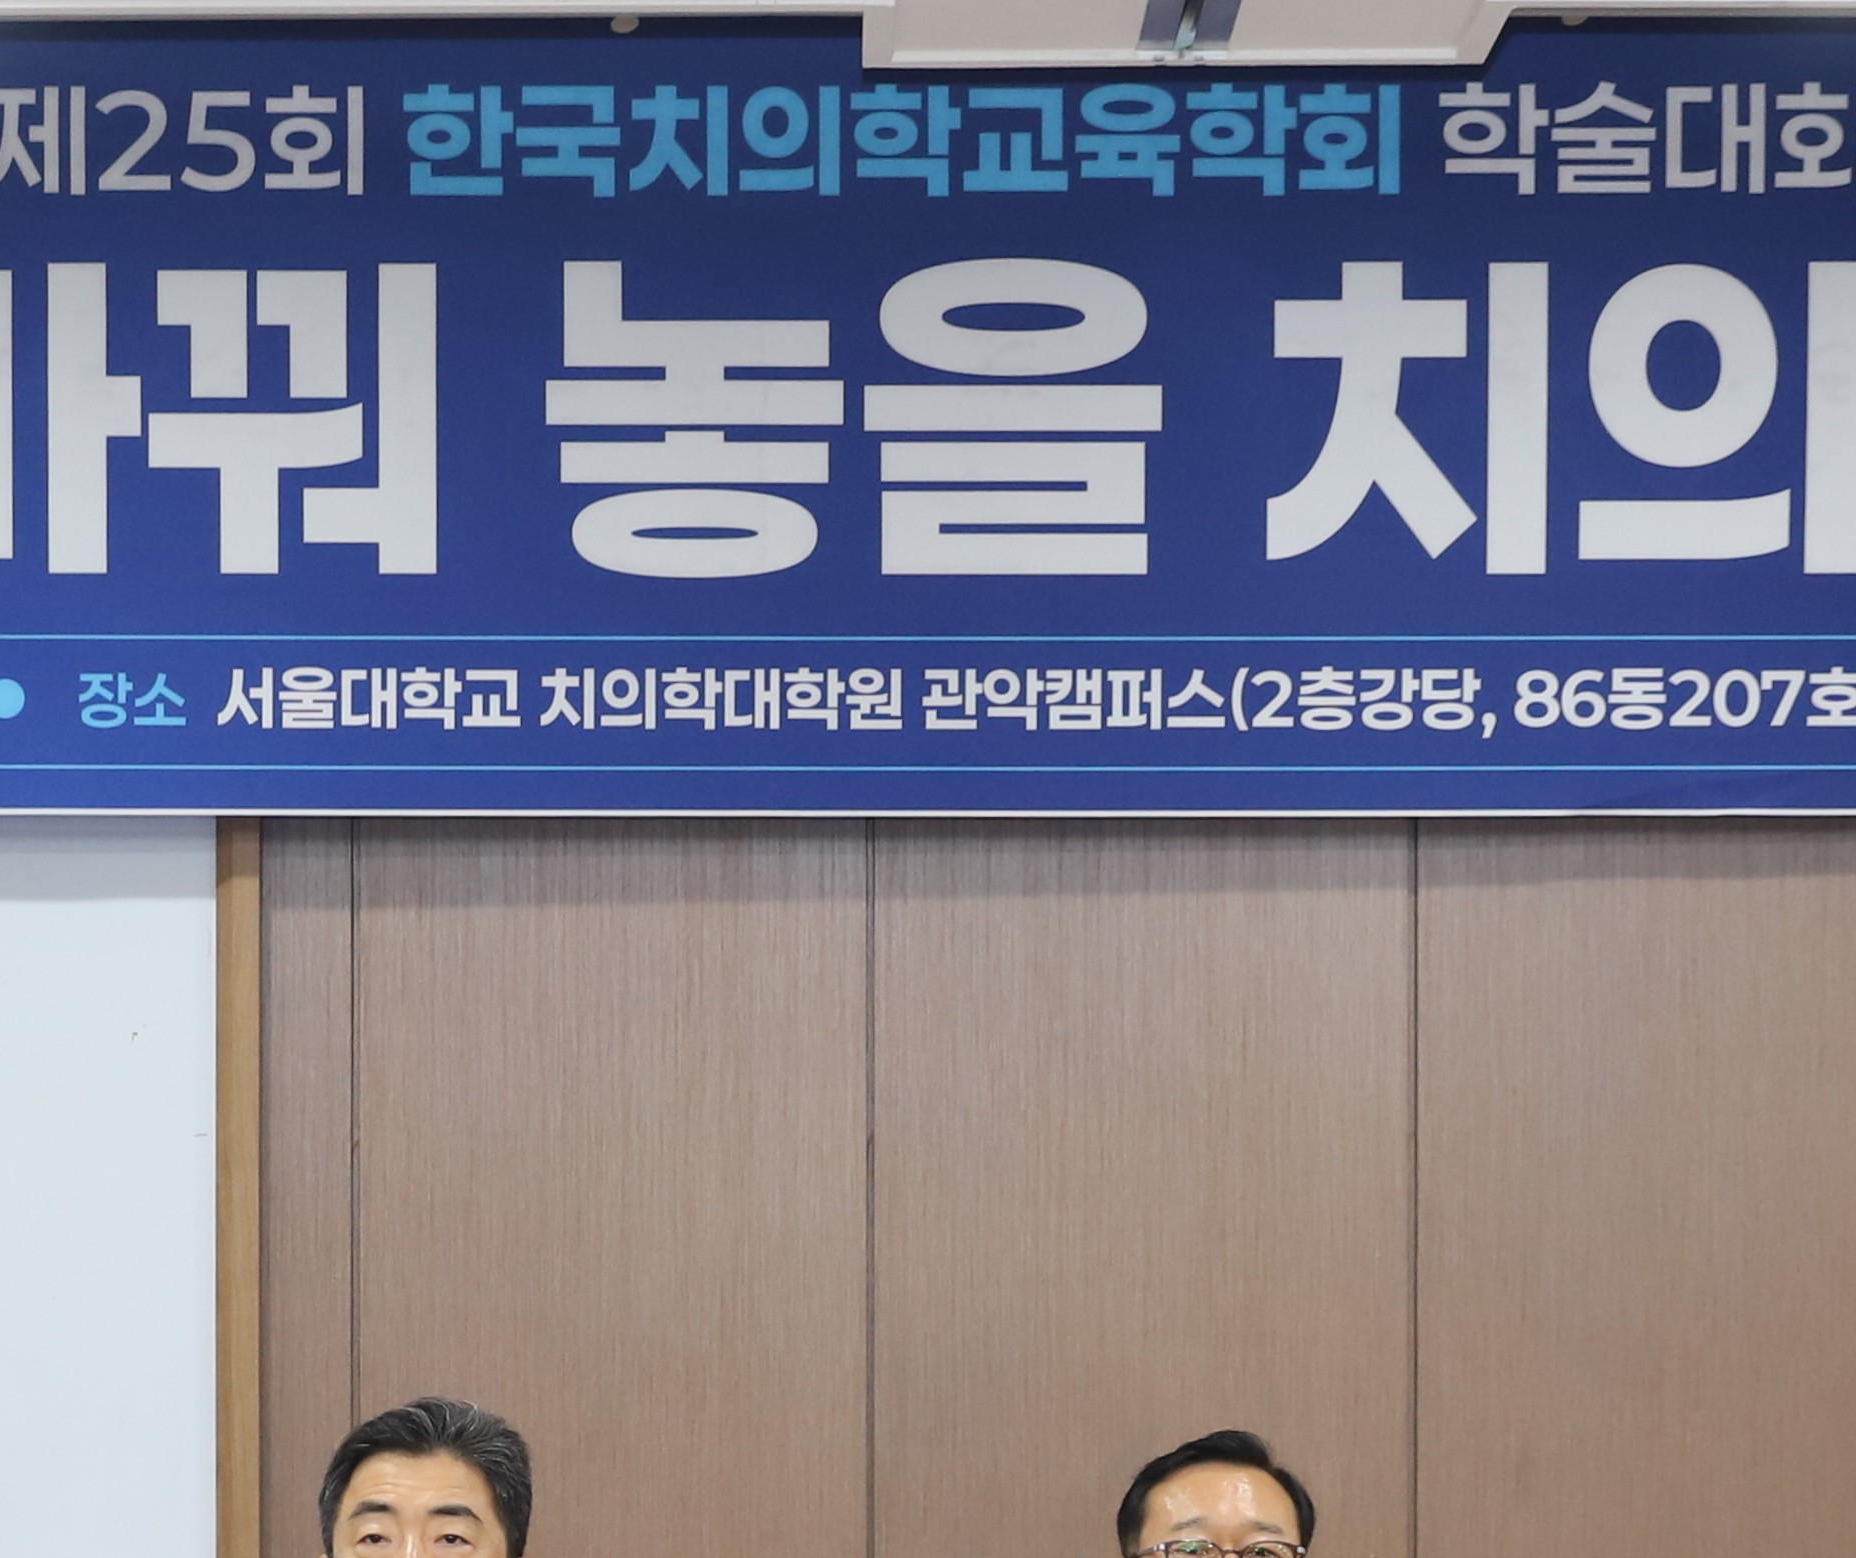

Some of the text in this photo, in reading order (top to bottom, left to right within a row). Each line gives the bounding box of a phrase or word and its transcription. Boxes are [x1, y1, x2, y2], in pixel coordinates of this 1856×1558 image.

[403, 83, 1399, 197] 한국치의학교육학회
[546, 259, 1163, 579] 놓을
[78, 671, 187, 729] 장소
[216, 667, 522, 731] 서울대학교
[539, 667, 903, 731] 치의학대학원
[921, 666, 1497, 739] 관악캠퍼스(2층강당,
